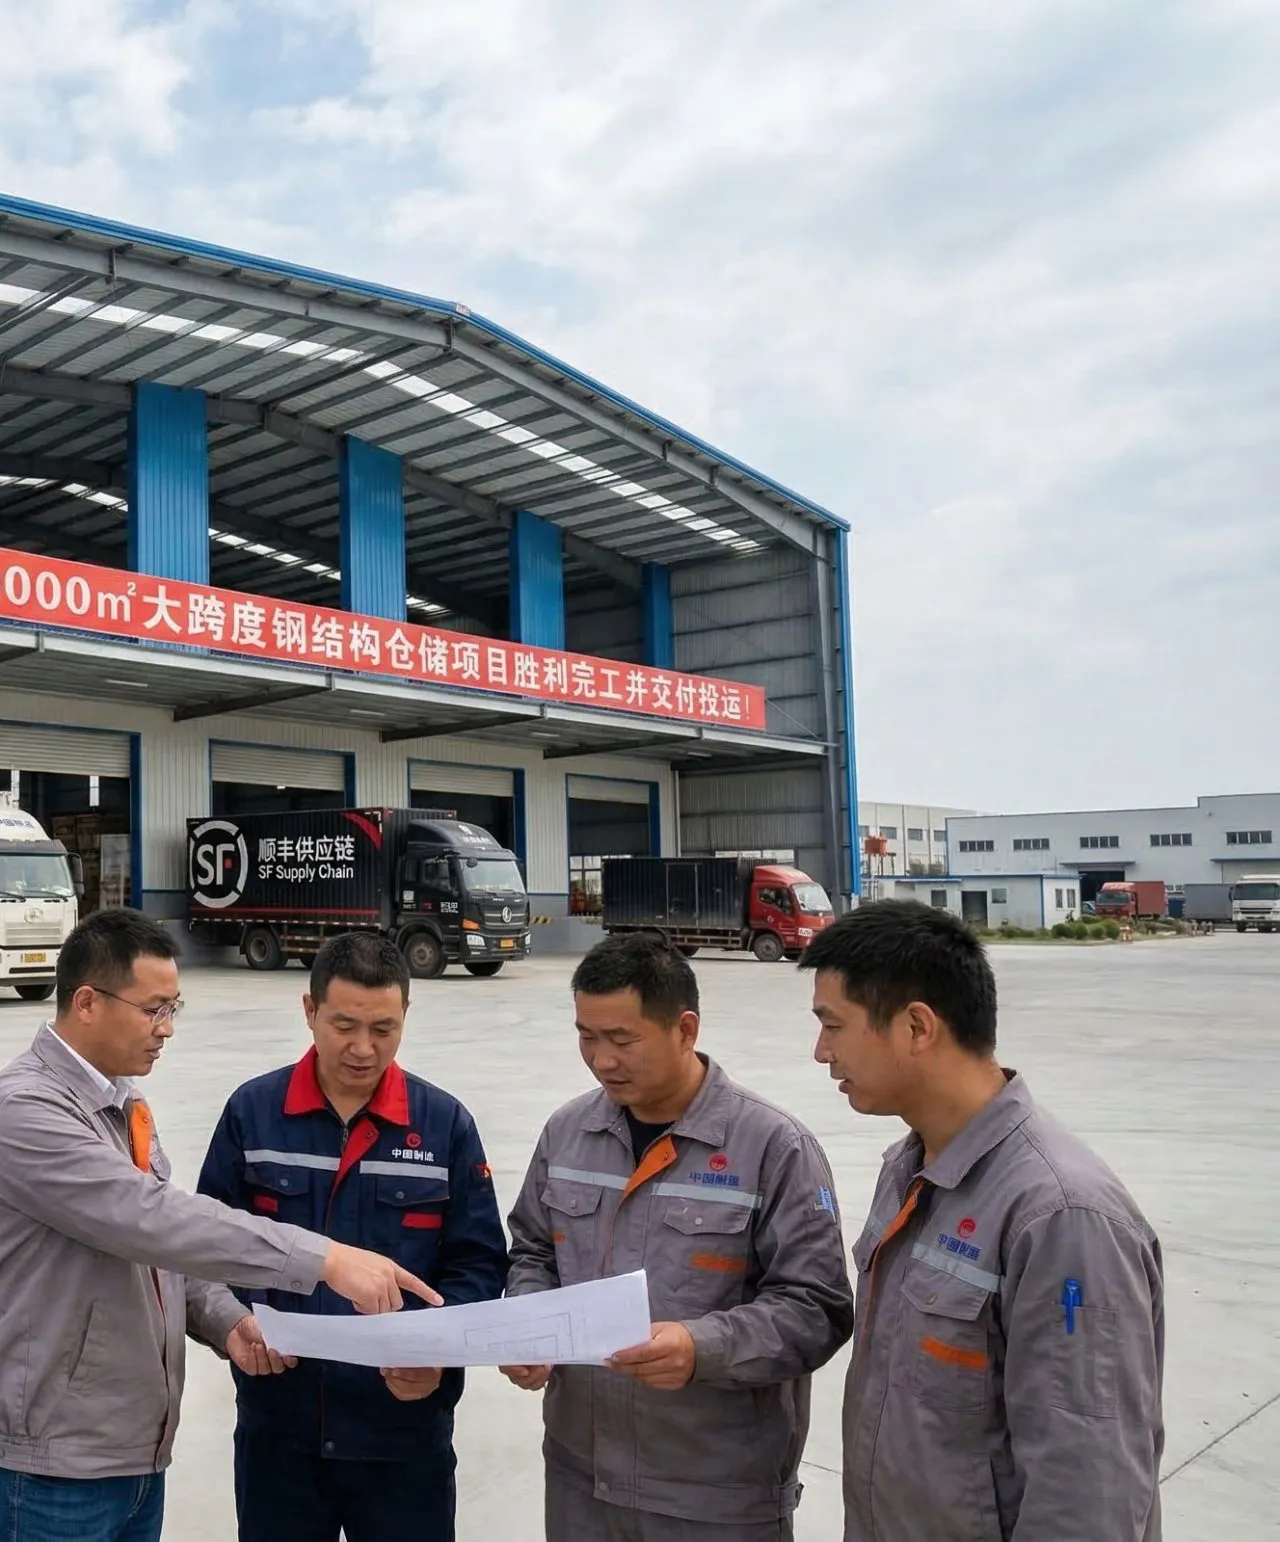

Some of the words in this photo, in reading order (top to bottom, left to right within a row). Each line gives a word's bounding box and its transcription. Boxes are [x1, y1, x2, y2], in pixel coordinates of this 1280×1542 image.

[257, 834, 355, 863] 顺丰供应链
[196, 843, 235, 886] SF
[258, 864, 274, 879] SF
[275, 863, 316, 883] Supply
[318, 862, 355, 879] Chain
